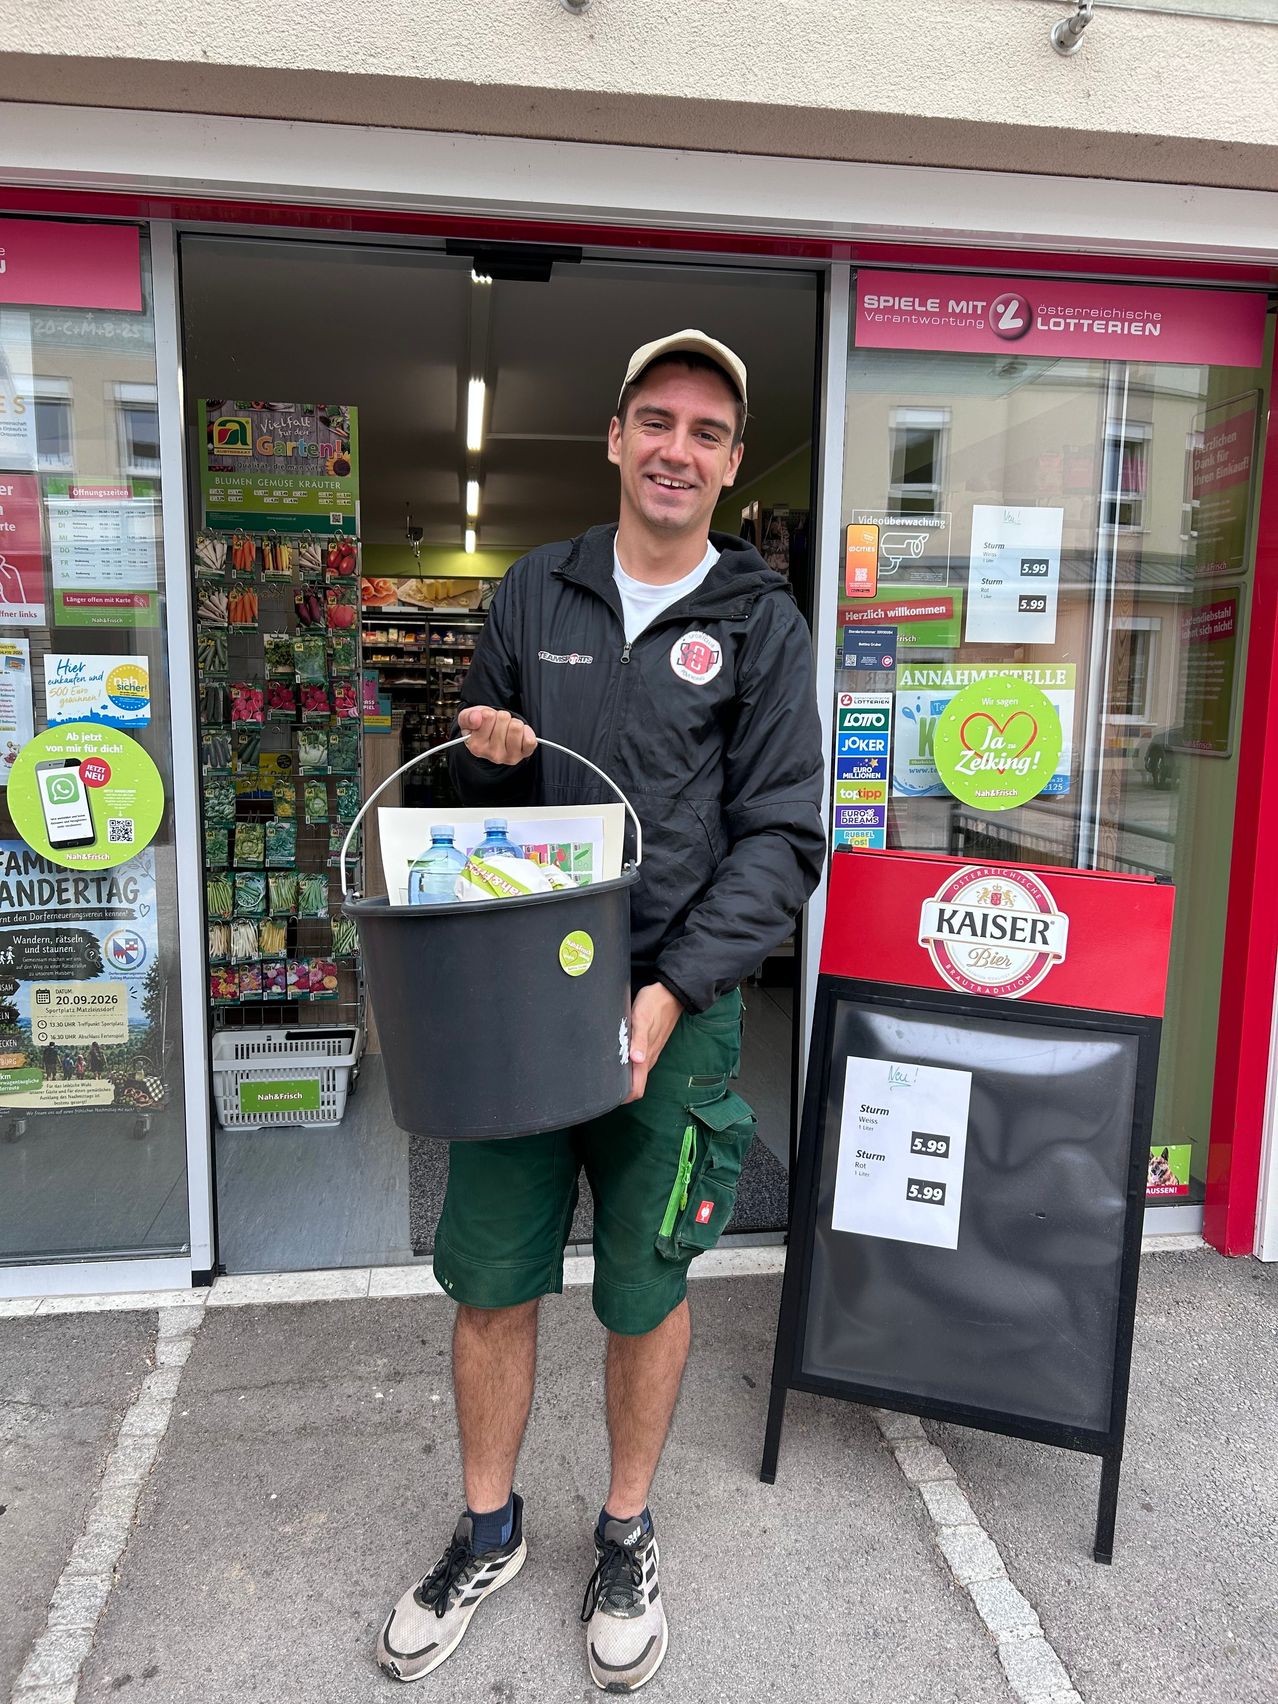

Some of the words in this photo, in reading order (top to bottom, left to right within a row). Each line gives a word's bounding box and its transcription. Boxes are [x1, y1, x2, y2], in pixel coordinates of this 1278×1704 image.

[864, 294, 940, 312] SPIELE
[948, 300, 987, 315] MIT
[1037, 303, 1162, 321] österreichische
[864, 311, 985, 329] Verantwortung
[1037, 318, 1161, 336] LOTTERIEN
[260, 415, 310, 433] Vielfalt
[256, 435, 342, 459] Garten!
[1194, 456, 1215, 471] Dank
[1217, 449, 1229, 461] für
[1194, 473, 1214, 486] Ihren
[1216, 456, 1249, 478] Einkauf!
[215, 477, 252, 485] BLUMEN
[258, 478, 294, 488] GEMÜSE
[299, 480, 341, 489] KRÄUTER
[72, 487, 129, 498] Öffnungszeiten
[858, 515, 946, 529] Videoüberwachung
[983, 541, 1005, 550] Sturm
[1022, 563, 1047, 574] 5.99
[981, 578, 1003, 586] Sturm
[66, 596, 86, 605] Länger
[1019, 600, 1044, 610] 5.99
[845, 610, 884, 621] Herzlich
[887, 604, 946, 617] willkommen
[1199, 625, 1212, 636] sich
[1213, 619, 1233, 632] nicht!
[56, 658, 86, 676] Hier
[47, 673, 87, 685] einkaufen
[89, 671, 104, 682] und
[113, 676, 138, 685] nah
[49, 687, 68, 697] 500
[70, 686, 88, 695] Euro
[117, 683, 147, 692] sicher!
[996, 698, 1019, 707] sagen
[843, 713, 885, 727] LOTTO
[66, 733, 79, 741] Ab
[81, 733, 102, 742] jetzt
[981, 725, 1006, 751] Ja
[66, 745, 81, 753] mir
[84, 745, 98, 753] für
[100, 745, 123, 753] dich!
[841, 736, 884, 751] JOKER
[86, 764, 106, 773] JETZT
[955, 750, 1041, 776] Zelking!
[85, 771, 105, 782] NEU
[975, 790, 1018, 798] Nah&Frisch
[841, 816, 879, 825] DREAMS
[66, 853, 110, 861] Nah&Frisch
[13, 913, 27, 922] den
[29, 909, 103, 922] Dorferneuerungsverein
[104, 909, 128, 917] kennen!
[936, 908, 1050, 945] KAISER
[13, 935, 53, 944] Wandern,
[55, 935, 83, 943] rätseln
[24, 945, 39, 954] und
[42, 945, 76, 953] staunen.
[967, 948, 1012, 970] Bier
[945, 964, 1032, 994] BRAUTRADITION
[56, 995, 118, 1005] 20.09.2026
[257, 1092, 303, 1101] Nah&Frisch
[860, 1104, 890, 1116] Sturm
[858, 1116, 878, 1125] Weiss
[912, 1138, 947, 1153] 5.99
[855, 1149, 886, 1162] Sturm
[855, 1161, 866, 1169] Rot
[908, 1185, 943, 1200] 5.99
